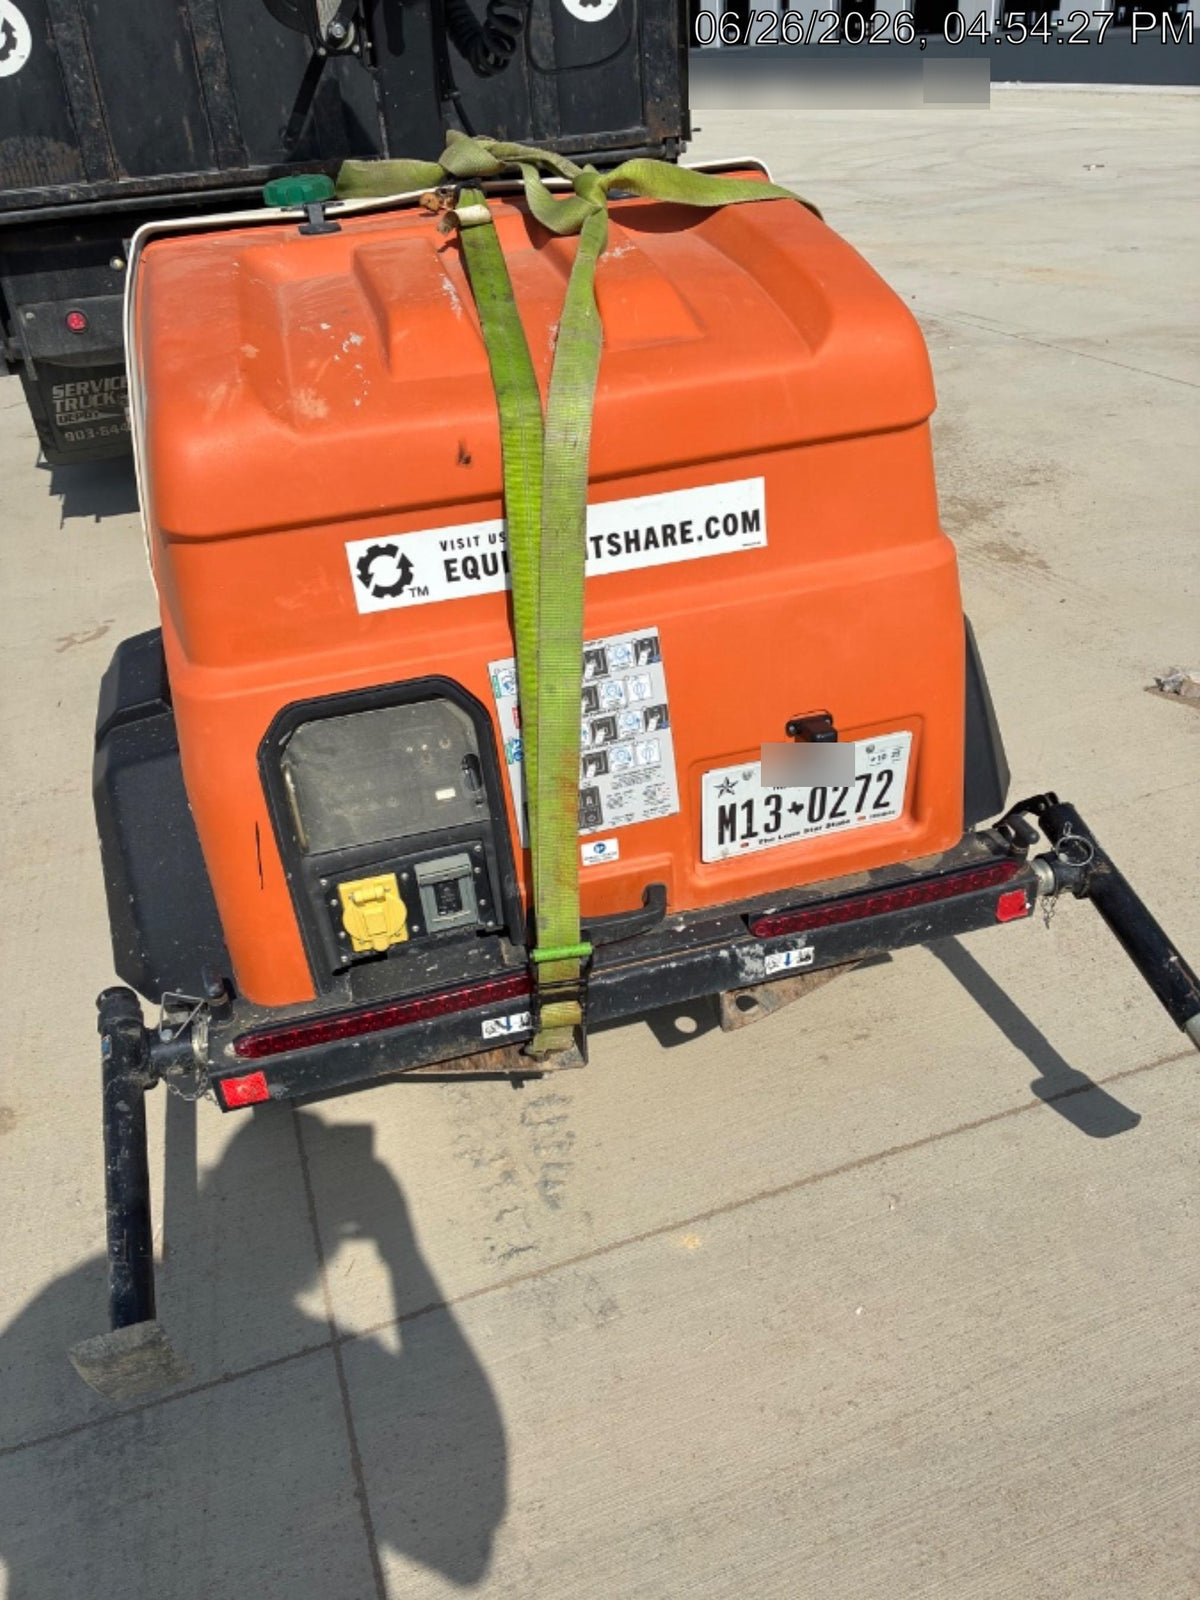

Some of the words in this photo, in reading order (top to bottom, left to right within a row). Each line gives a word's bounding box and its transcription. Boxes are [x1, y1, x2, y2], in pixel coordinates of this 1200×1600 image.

[439, 535, 480, 552] VISIT
[488, 531, 507, 545] US
[444, 509, 761, 583] EQUITSHARE.COM
[408, 585, 430, 598] TM
[718, 794, 782, 845] M13
[807, 769, 894, 824] 0272
